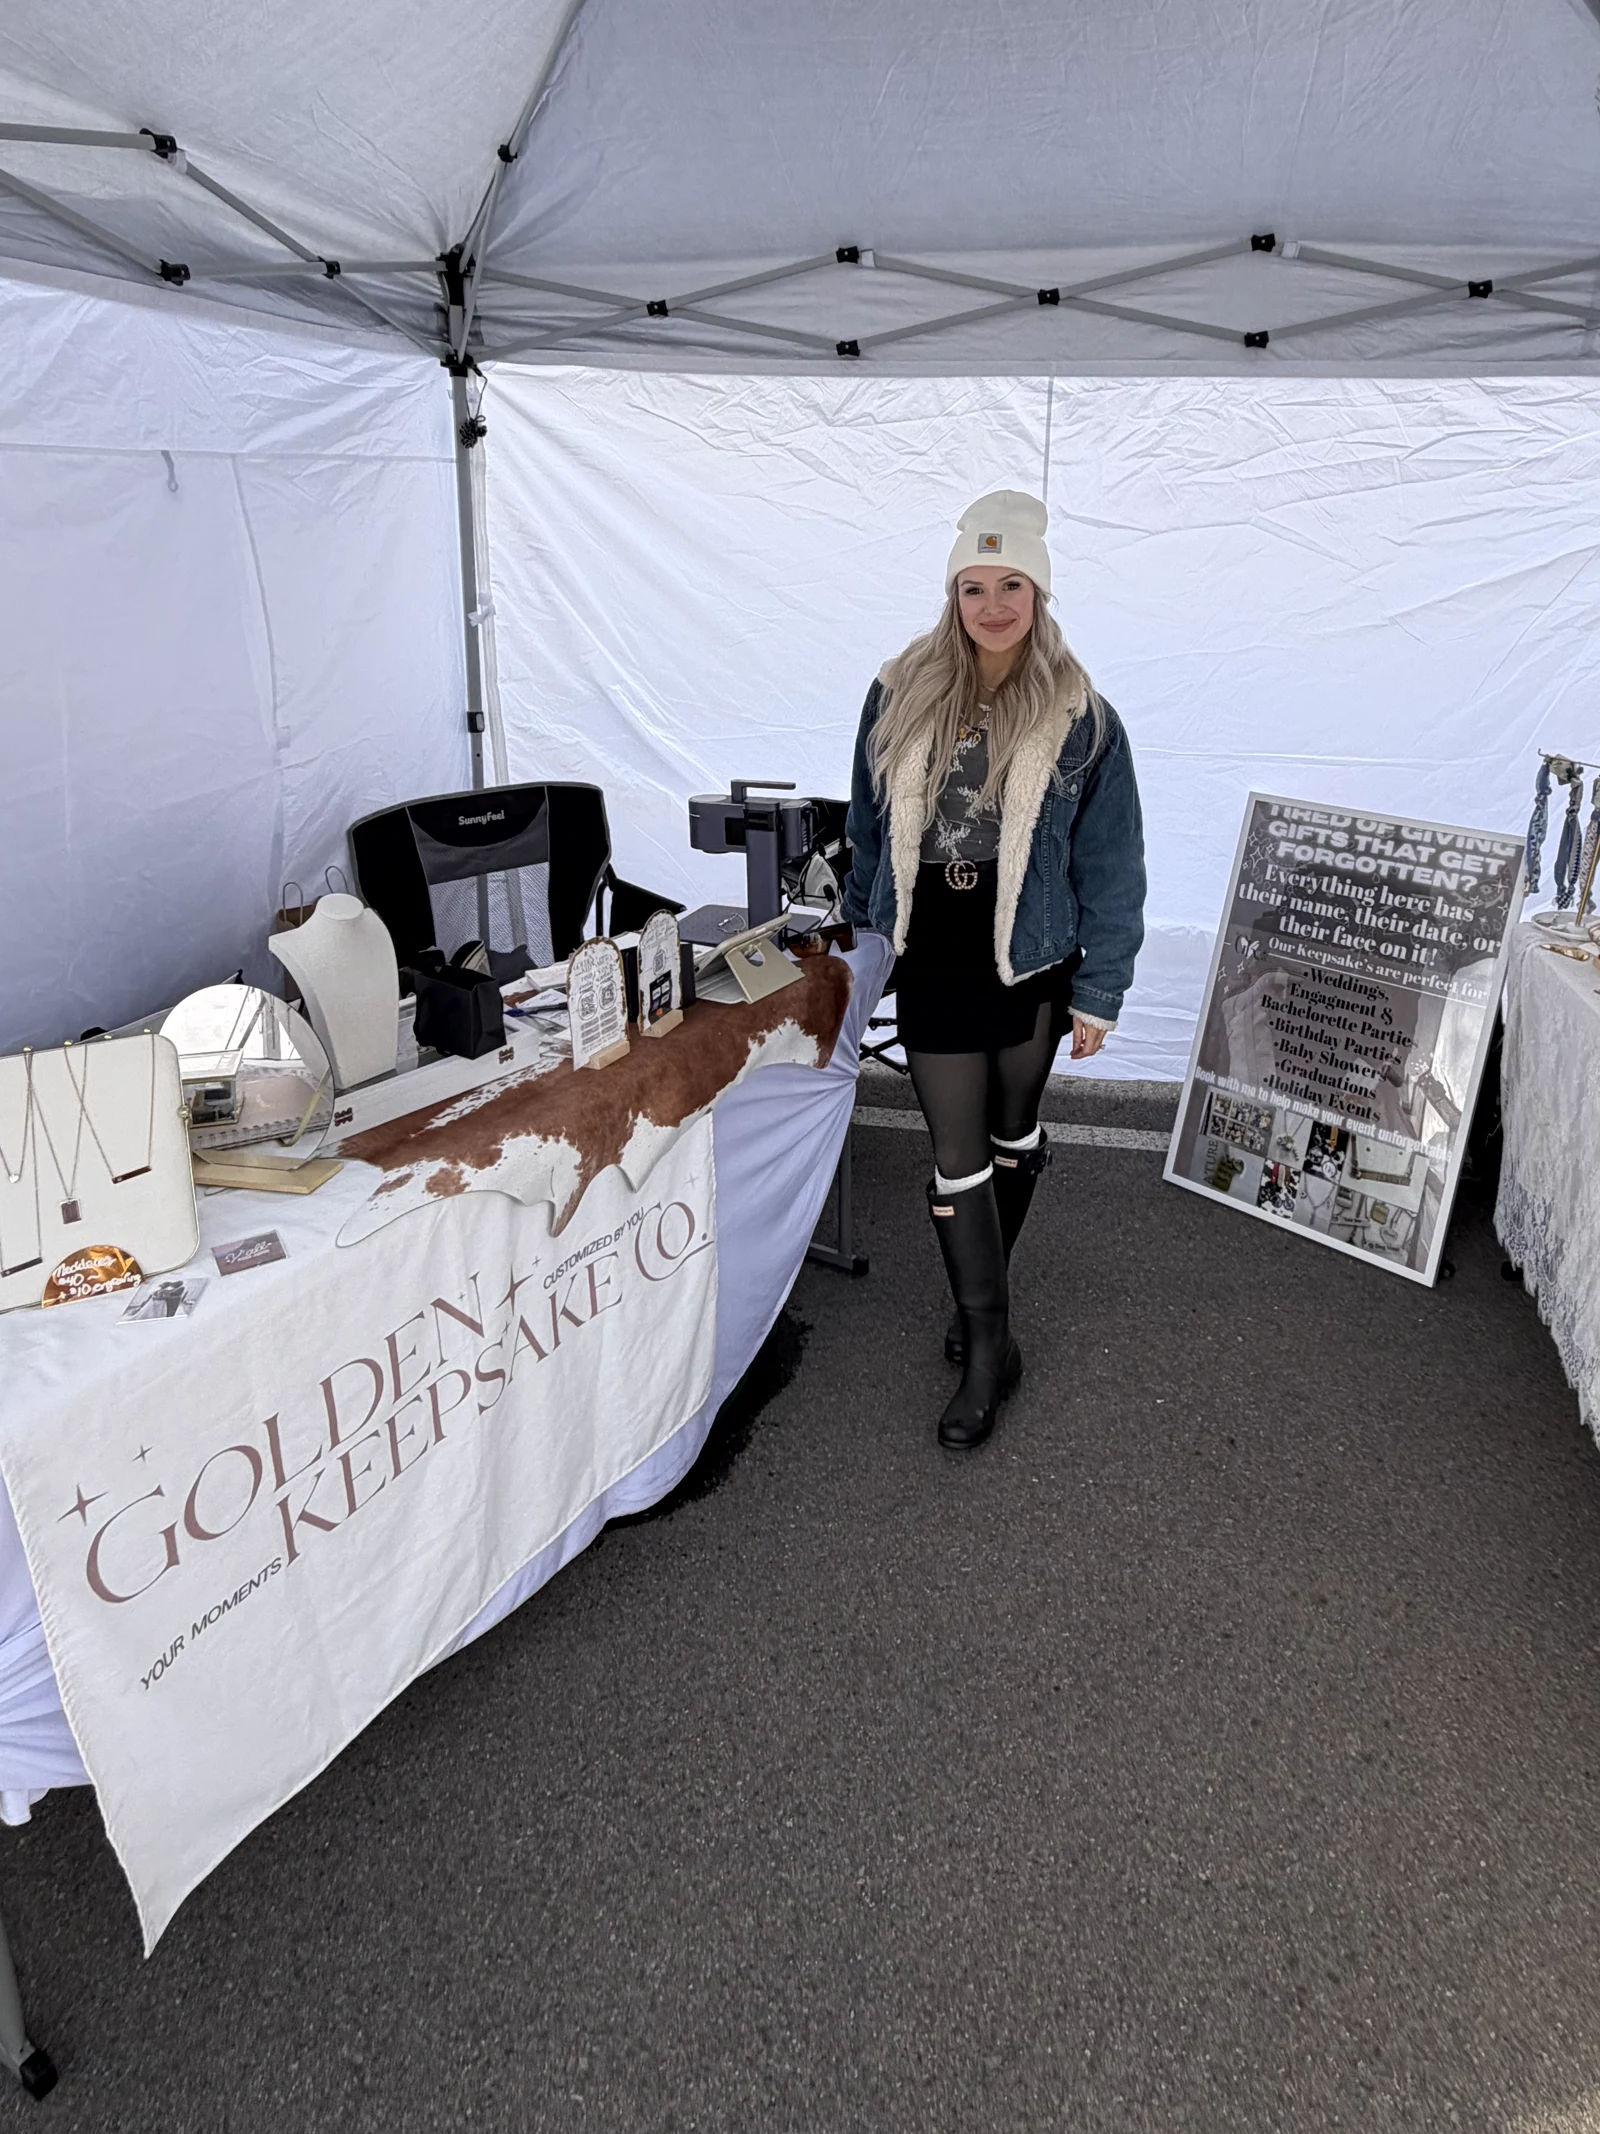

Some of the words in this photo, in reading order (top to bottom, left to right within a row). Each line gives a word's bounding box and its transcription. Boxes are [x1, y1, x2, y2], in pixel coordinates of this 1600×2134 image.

[458, 810, 505, 825] SunnyFeel
[1356, 818, 1395, 835] OF
[1400, 826, 1516, 857] GIVING
[1268, 820, 1349, 848] GIFTS
[1354, 835, 1436, 863] THAT
[1438, 850, 1506, 876] GET
[1275, 842, 1478, 892] FORGOTTEN?
[1239, 883, 1287, 907] their
[1290, 898, 1350, 924] name,
[1354, 907, 1410, 934] their
[1412, 918, 1468, 951] date,
[1473, 936, 1501, 955] or
[1264, 864, 1378, 906] Everything
[1380, 885, 1430, 914] here
[1434, 896, 1475, 922] has
[1268, 937, 1296, 953] Our
[1297, 943, 1373, 974] Keepsake's
[1375, 963, 1401, 980] are
[1402, 970, 1458, 994] perfect
[1461, 982, 1487, 1001] for
[1279, 915, 1330, 941] their
[1332, 926, 1376, 954] face
[1379, 940, 1408, 960] on
[1411, 945, 1438, 968] it!
[1260, 994, 1358, 1032] Bachelorette
[1360, 1021, 1419, 1049] Parties
[1290, 983, 1376, 1017] Engagment
[1380, 1007, 1393, 1026] &
[1344, 1037, 1402, 1065] Parties
[1195, 1066, 1216, 1084] Book
[1217, 1075, 1240, 1092] with
[1258, 1086, 1269, 1102] to
[1270, 1091, 1291, 1111] help
[1292, 1100, 1320, 1121] make
[1321, 1109, 1346, 1129] your
[1346, 1116, 1376, 1137] event
[1328, 1091, 1382, 1123] Events
[543, 1234, 613, 1290] CUSTOMIZED
[614, 1226, 625, 1242] BY
[626, 1207, 645, 1231] YOU
[275, 1251, 623, 1567] KEEPSAKE
[635, 1202, 714, 1281] CO.
[86, 1271, 485, 1603] GOLDEN
[140, 1635, 185, 1691] YOUR
[191, 1557, 282, 1640] MOMENTS
